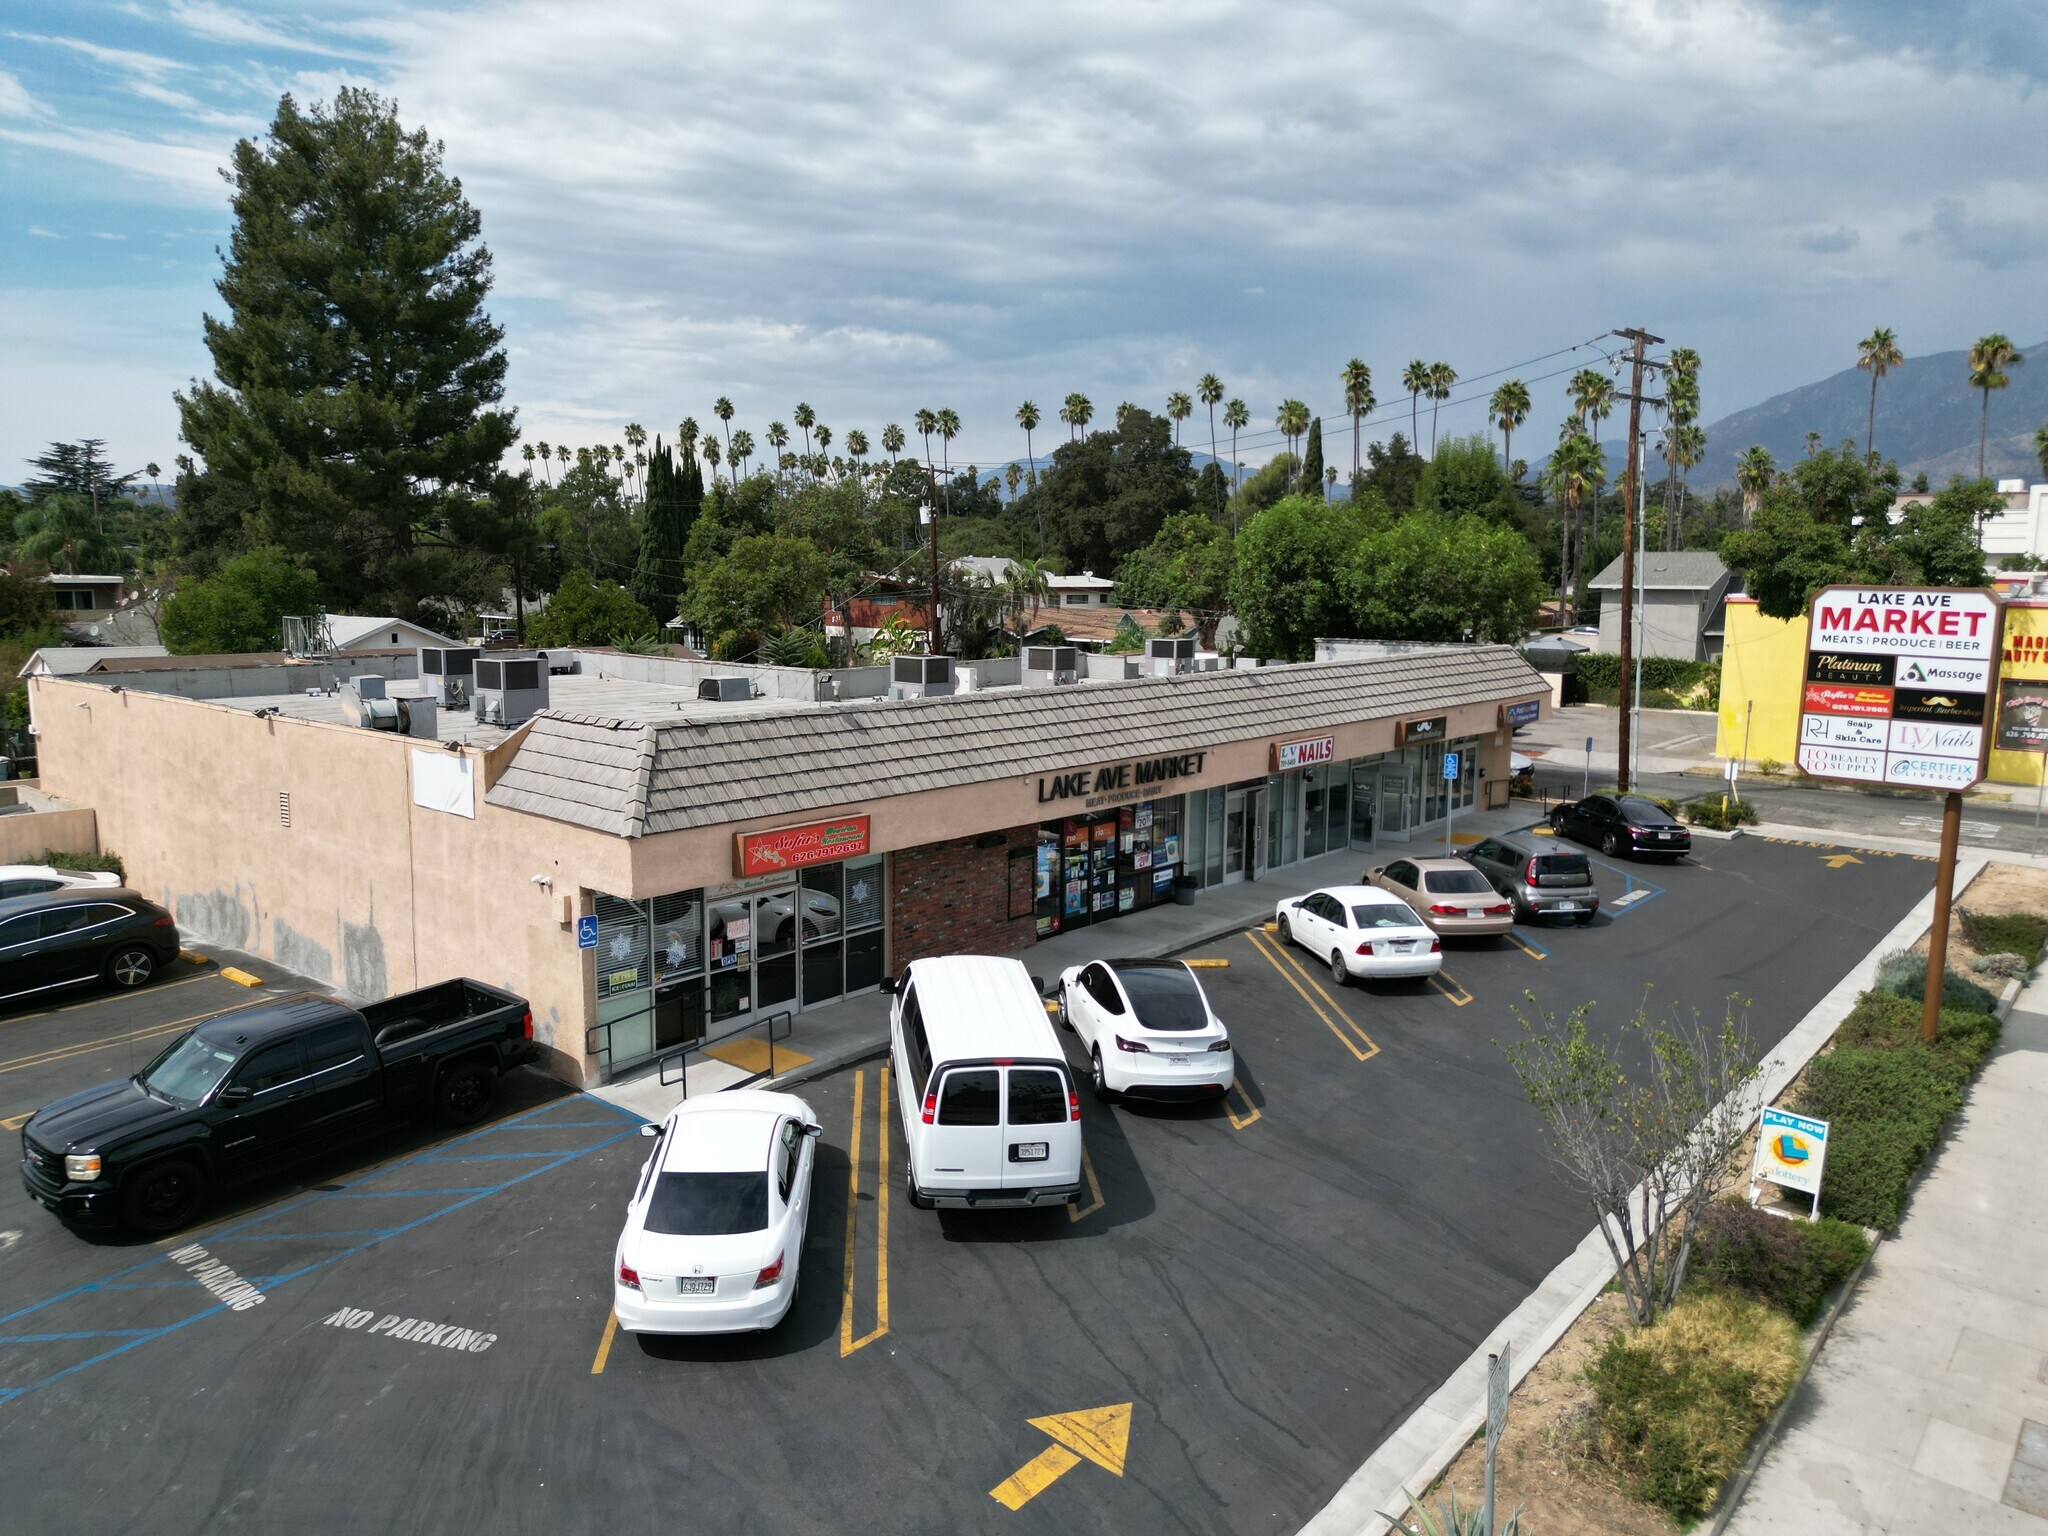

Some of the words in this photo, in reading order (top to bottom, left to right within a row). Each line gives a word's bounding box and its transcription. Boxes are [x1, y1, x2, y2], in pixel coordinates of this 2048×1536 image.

[1858, 593, 1905, 605] LAKE
[1912, 594, 1951, 607] AVE
[1820, 607, 1987, 637] MARKET
[1822, 635, 1863, 645] MEATS
[1872, 637, 1936, 648] PRODUCE
[1946, 641, 1980, 650] BEER
[1818, 655, 1883, 672] Platinum
[2003, 650, 2039, 663] AUTY
[1816, 672, 1882, 681] BEAUTY
[1927, 668, 1983, 682] Massage
[1847, 720, 1873, 729] Scalp
[1835, 734, 1856, 742] Skin
[1860, 736, 1882, 744] Care
[1900, 726, 1929, 744] LV
[1912, 729, 1974, 751] Nails
[1298, 739, 1331, 763] NAILS
[1804, 748, 1828, 760] TO
[1803, 760, 1827, 771] TO
[1831, 754, 1878, 765] BEAUTY
[1830, 762, 1878, 773] SUPPLY
[1911, 760, 1972, 774] CERTIFIX
[1038, 771, 1091, 803] LAKE
[1094, 764, 1131, 792] AVE
[1135, 752, 1207, 785] MARKET
[1905, 772, 1972, 782] LIVESCAN
[723, 955, 736, 965] OPEN
[1765, 1112, 1794, 1125] PLAY
[1798, 1120, 1824, 1134] NOW
[167, 1243, 209, 1265] NO
[185, 1257, 266, 1311] PARKING
[323, 1306, 374, 1329] NO
[367, 1314, 497, 1353] PARKING
